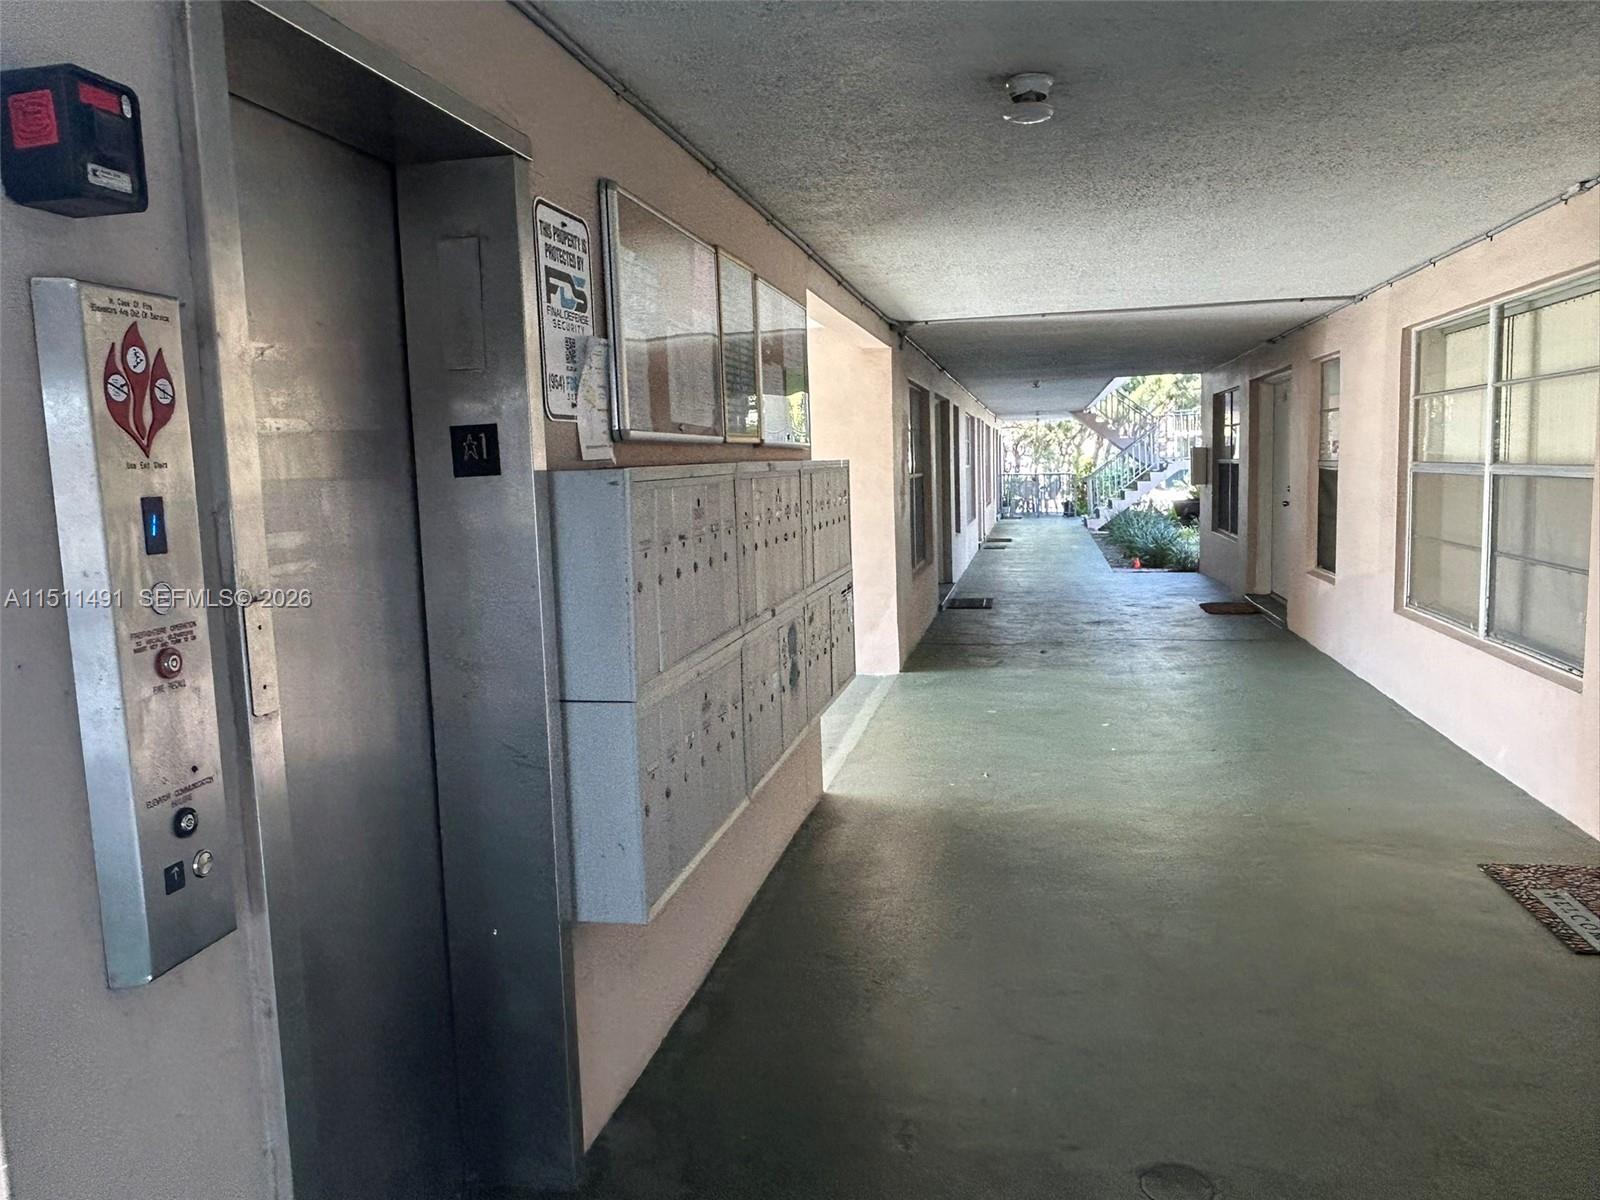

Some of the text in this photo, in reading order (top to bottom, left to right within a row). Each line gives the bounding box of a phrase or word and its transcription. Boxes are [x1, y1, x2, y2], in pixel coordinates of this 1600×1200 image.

[552, 225, 581, 252] PROPERTY
[544, 242, 576, 269] PROTECTED
[552, 318, 585, 336] SECURITY
[548, 372, 565, 393] (954)
[479, 432, 487, 460] 1
